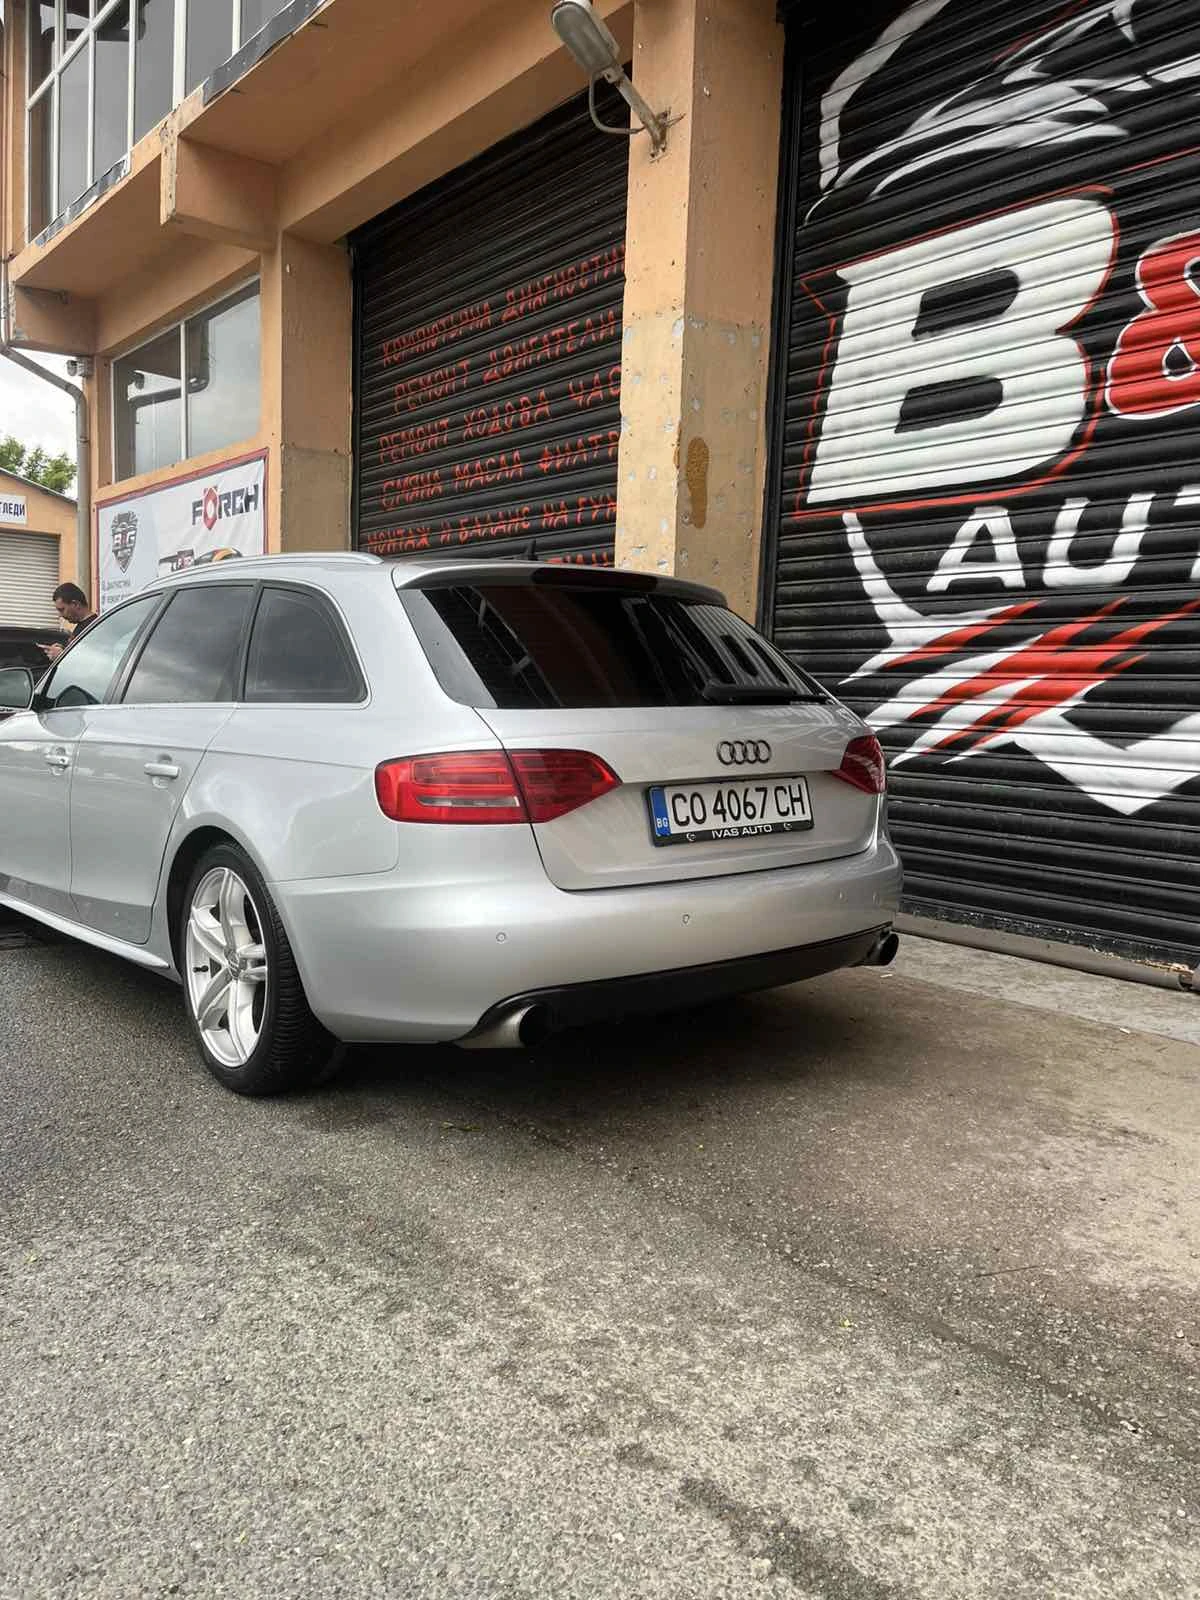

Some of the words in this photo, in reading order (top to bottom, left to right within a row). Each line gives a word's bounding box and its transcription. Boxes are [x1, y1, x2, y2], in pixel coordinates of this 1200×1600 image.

[499, 242, 625, 322] ДИАГНОСТИ
[393, 359, 471, 414] РЕМОНТ
[482, 309, 616, 384] ДВИГАТЕЛИ
[378, 418, 449, 465] РЕМОНТ
[462, 388, 551, 441] ХОДОВА
[0, 502, 26, 517] ЛЕДИ
[382, 469, 443, 512] СМЯНА
[453, 448, 522, 493] МАСЛА
[366, 526, 432, 555] МОНТАЖ
[440, 519, 451, 544] И
[458, 506, 531, 544] БАЛАНС
[542, 500, 569, 529] НА
[926, 484, 1200, 592] AU
[656, 817, 669, 829] BG
[671, 791, 707, 827] CO
[712, 786, 768, 823] 4067
[773, 783, 806, 817] CH
[712, 827, 740, 839] IVAS
[742, 823, 773, 835] AUTO
